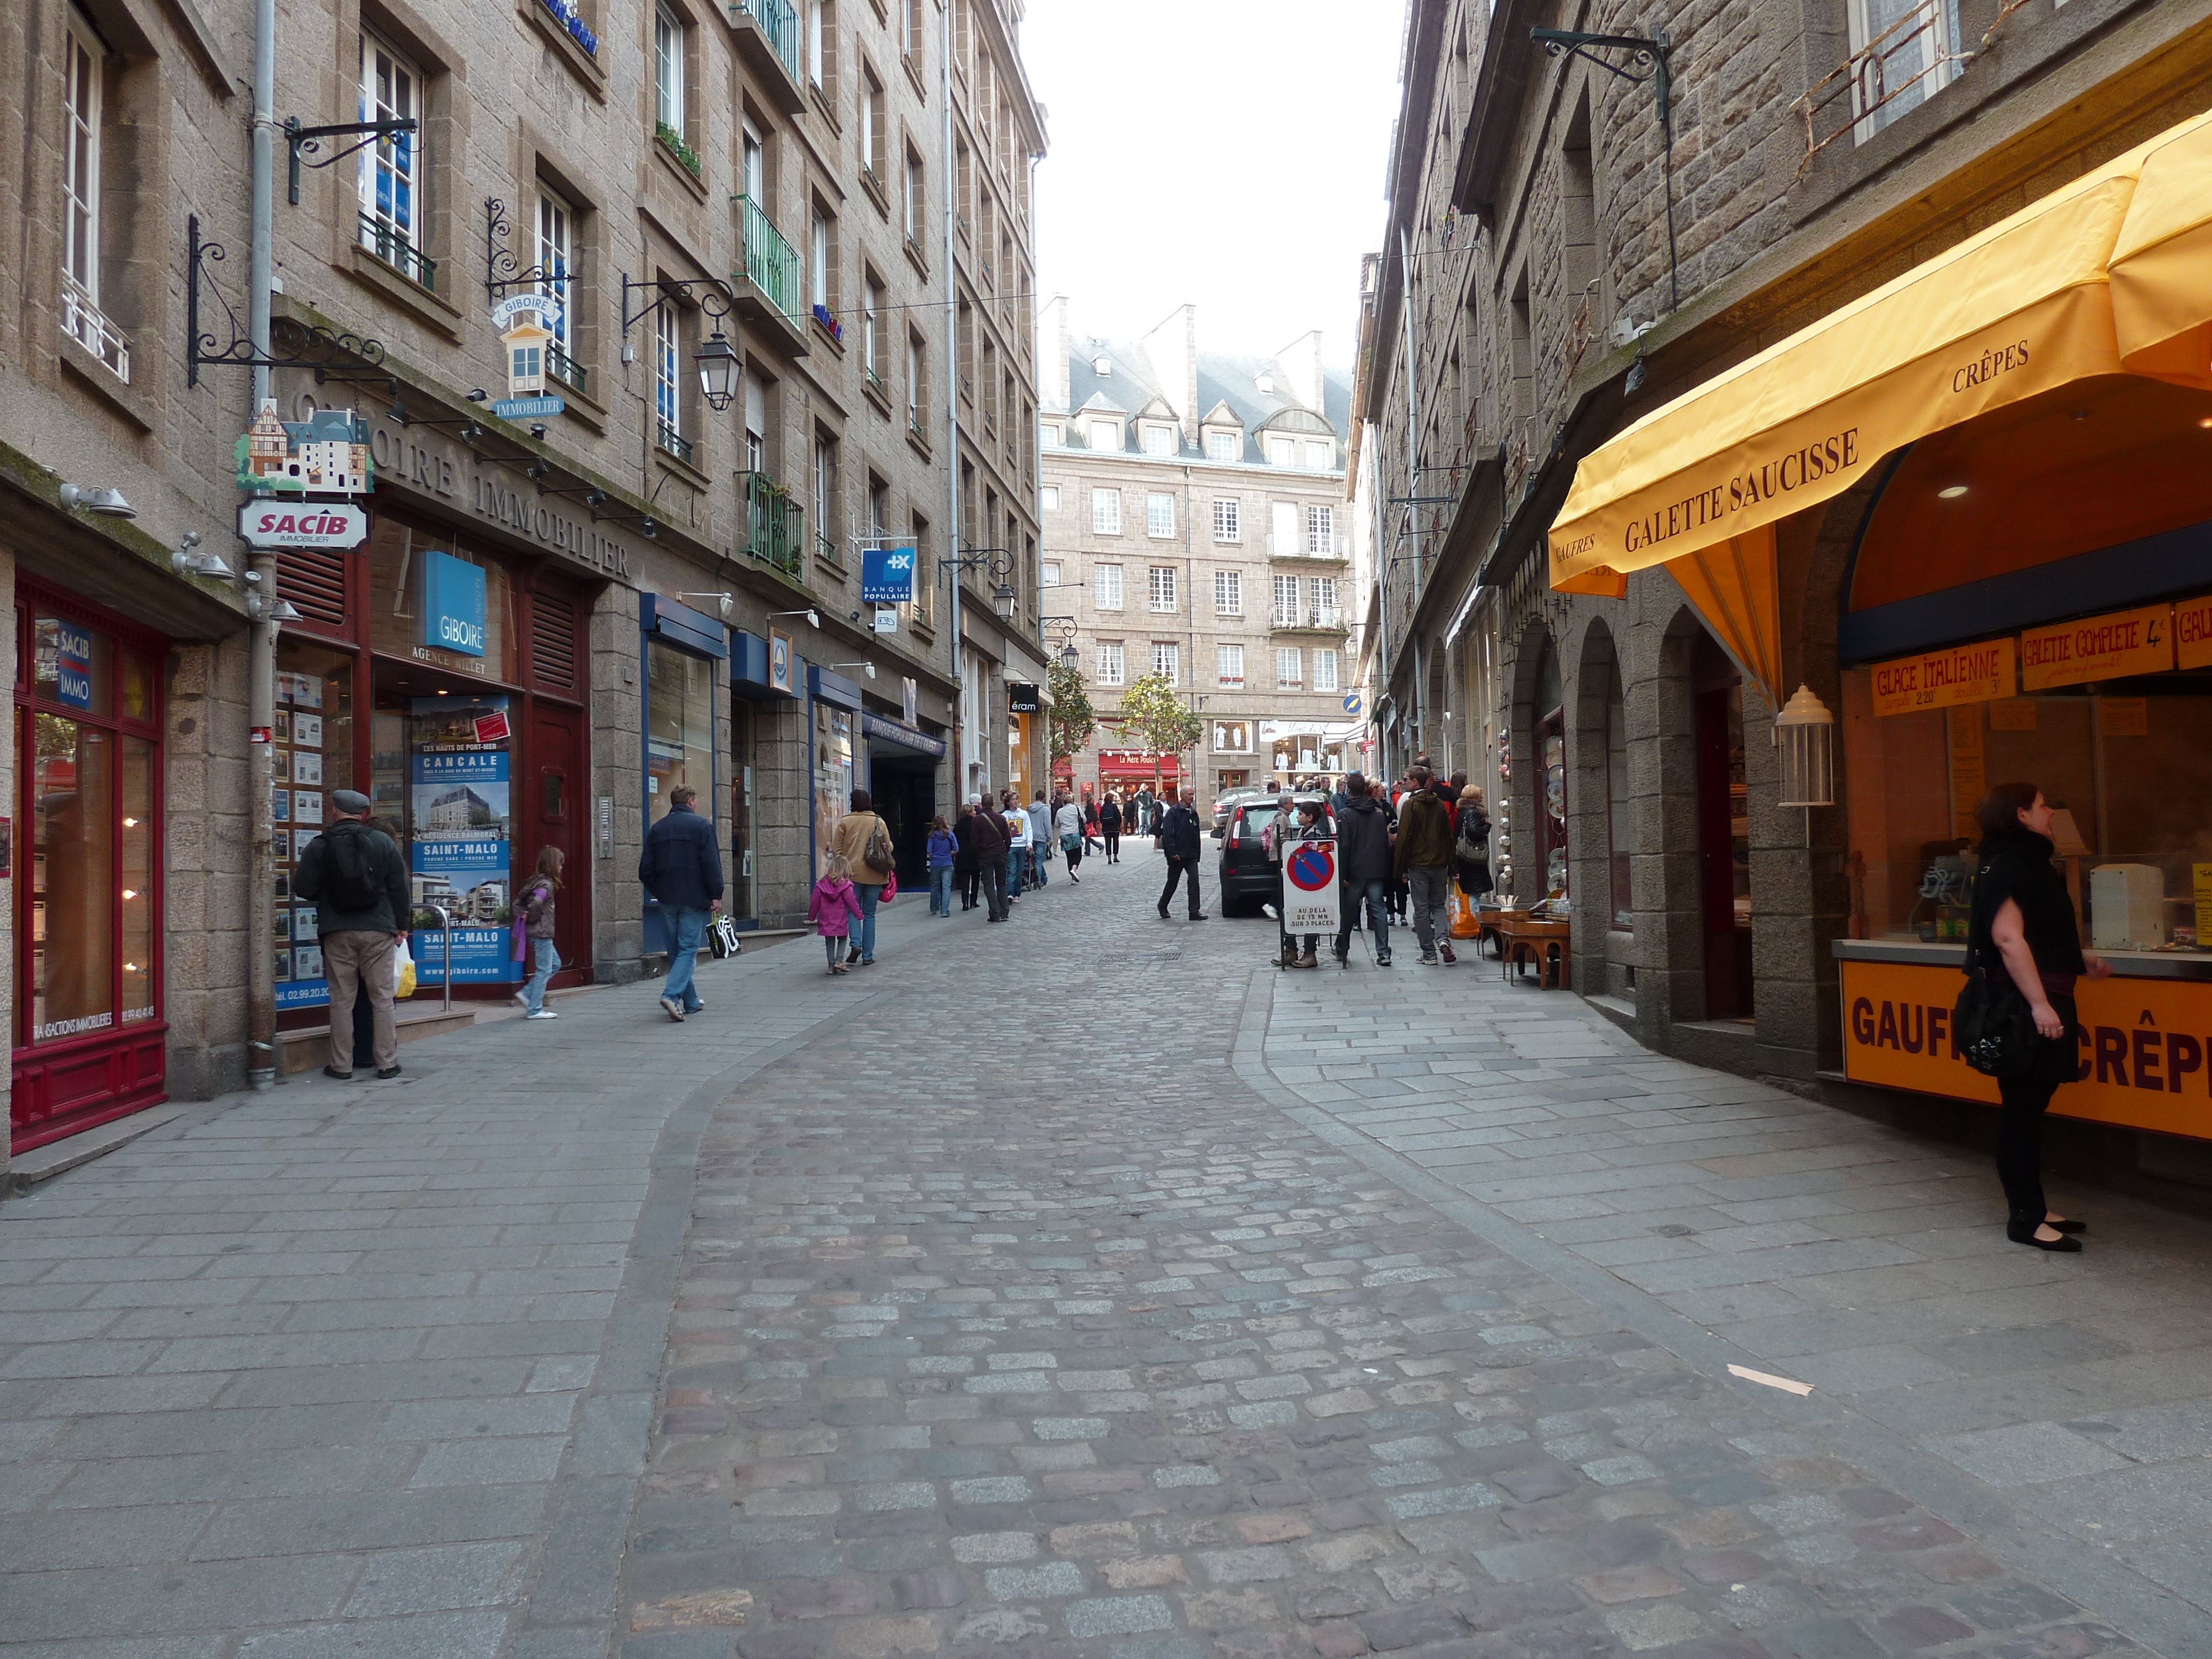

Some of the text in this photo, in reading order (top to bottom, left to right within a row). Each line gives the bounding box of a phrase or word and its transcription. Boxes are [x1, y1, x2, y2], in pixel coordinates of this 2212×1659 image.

[1953, 338, 2028, 393] CRÊPES
[496, 400, 560, 416] IMMOBILIER
[1625, 427, 1859, 553] GALETTE SAUCISSE
[474, 475, 631, 578] IMMOBILIER
[1556, 533, 1595, 564] GAUFRES
[61, 631, 90, 660] SACIB
[441, 615, 483, 649] GIBOIRE
[2024, 635, 2071, 667] GALETTE
[2076, 620, 2140, 658] COMPLETE
[412, 646, 449, 666] AGENCE
[61, 674, 89, 700] IMMO
[1877, 665, 1917, 696] GLACE
[1011, 701, 1036, 711] éram
[871, 719, 891, 737] BANQUE
[424, 756, 497, 767] CANCALE
[1126, 754, 1139, 764] Mère
[424, 843, 498, 855] SAINT-MALO
[2077, 1009, 2212, 1098] CRÊP
